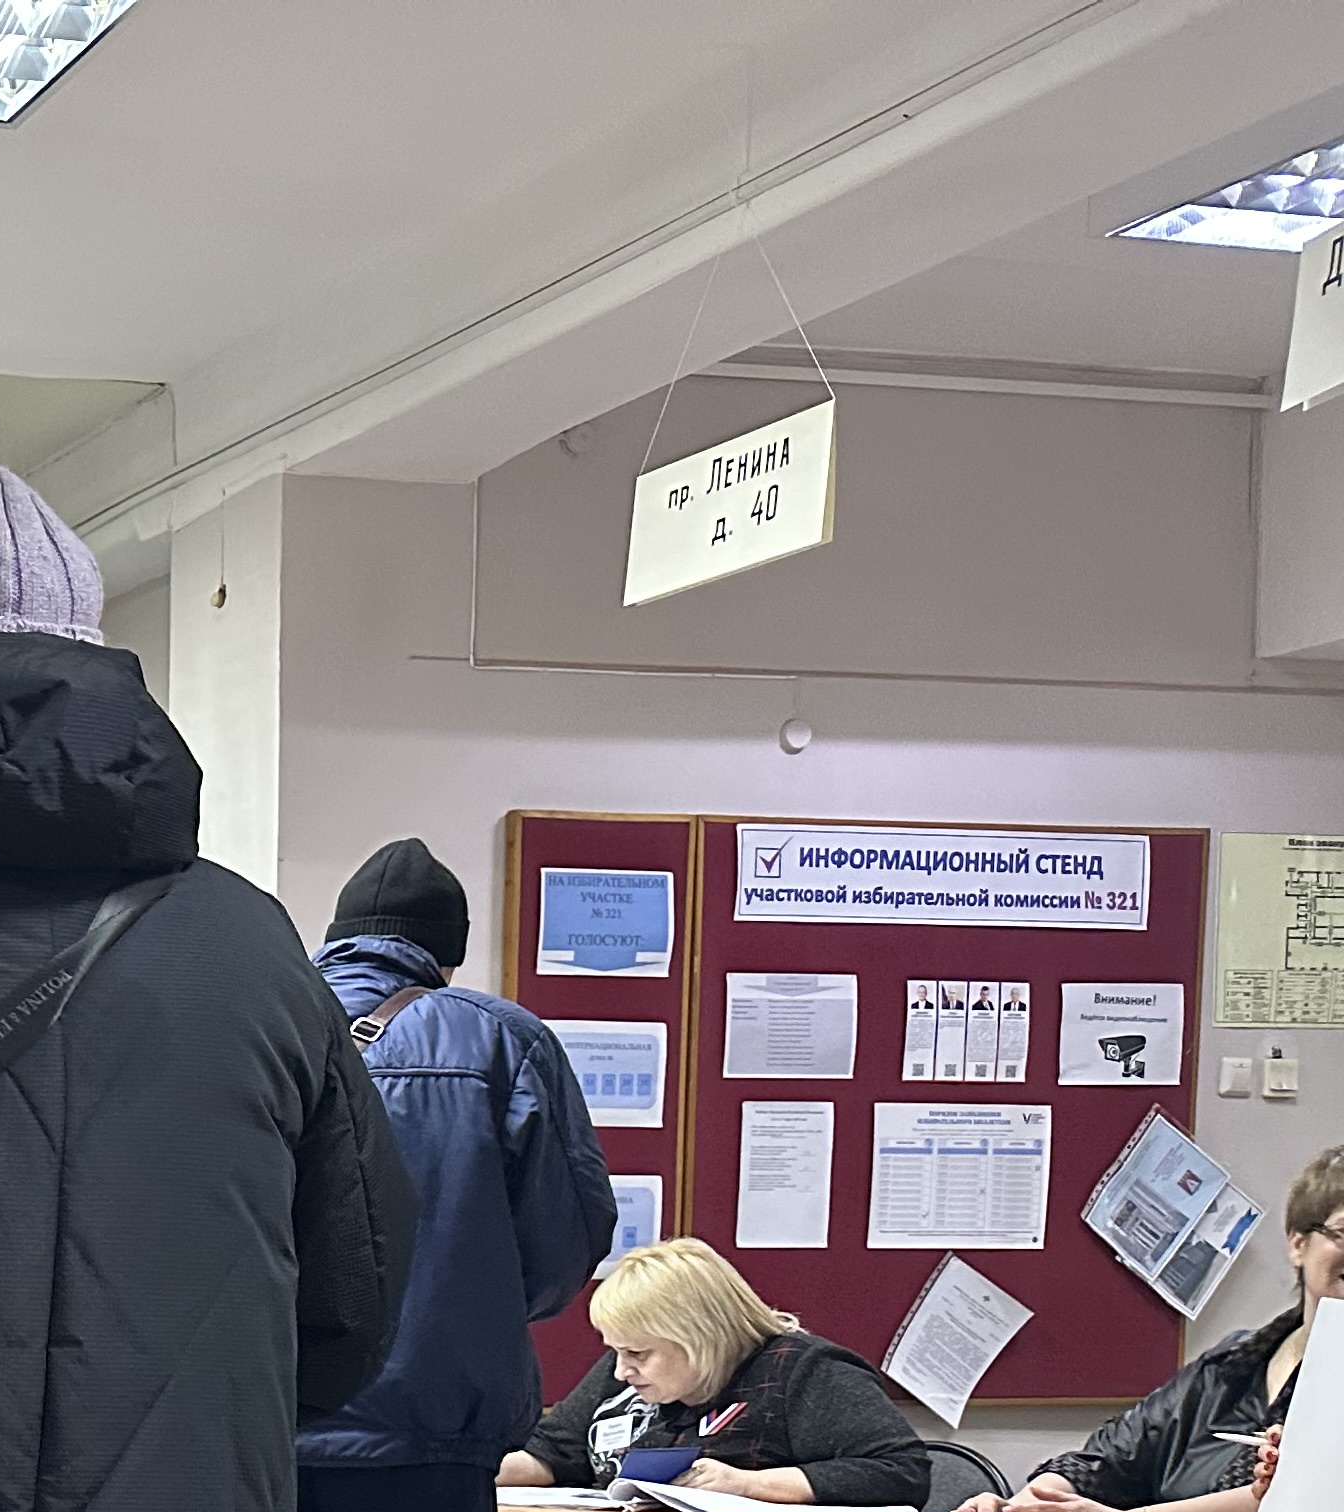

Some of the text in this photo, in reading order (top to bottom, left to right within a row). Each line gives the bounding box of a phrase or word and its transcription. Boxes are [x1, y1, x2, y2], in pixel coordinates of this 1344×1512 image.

[667, 484, 695, 511] пр.
[711, 483, 780, 547] д. 40
[799, 846, 1104, 880] ИНФОРМАЦИОННЫЙ СТЕНД
[548, 875, 667, 889] НА ИЗБИРАТЕЛЬНОМ
[580, 891, 634, 904] УЧАСТКЕ
[743, 885, 1140, 911] участковой избирательной комиссии № 321
[605, 908, 622, 920] 321
[567, 933, 645, 947] ГОЛОСУЮТ:
[16, 968, 73, 1016] POLINA
[1093, 992, 1157, 1006] Внимание!
